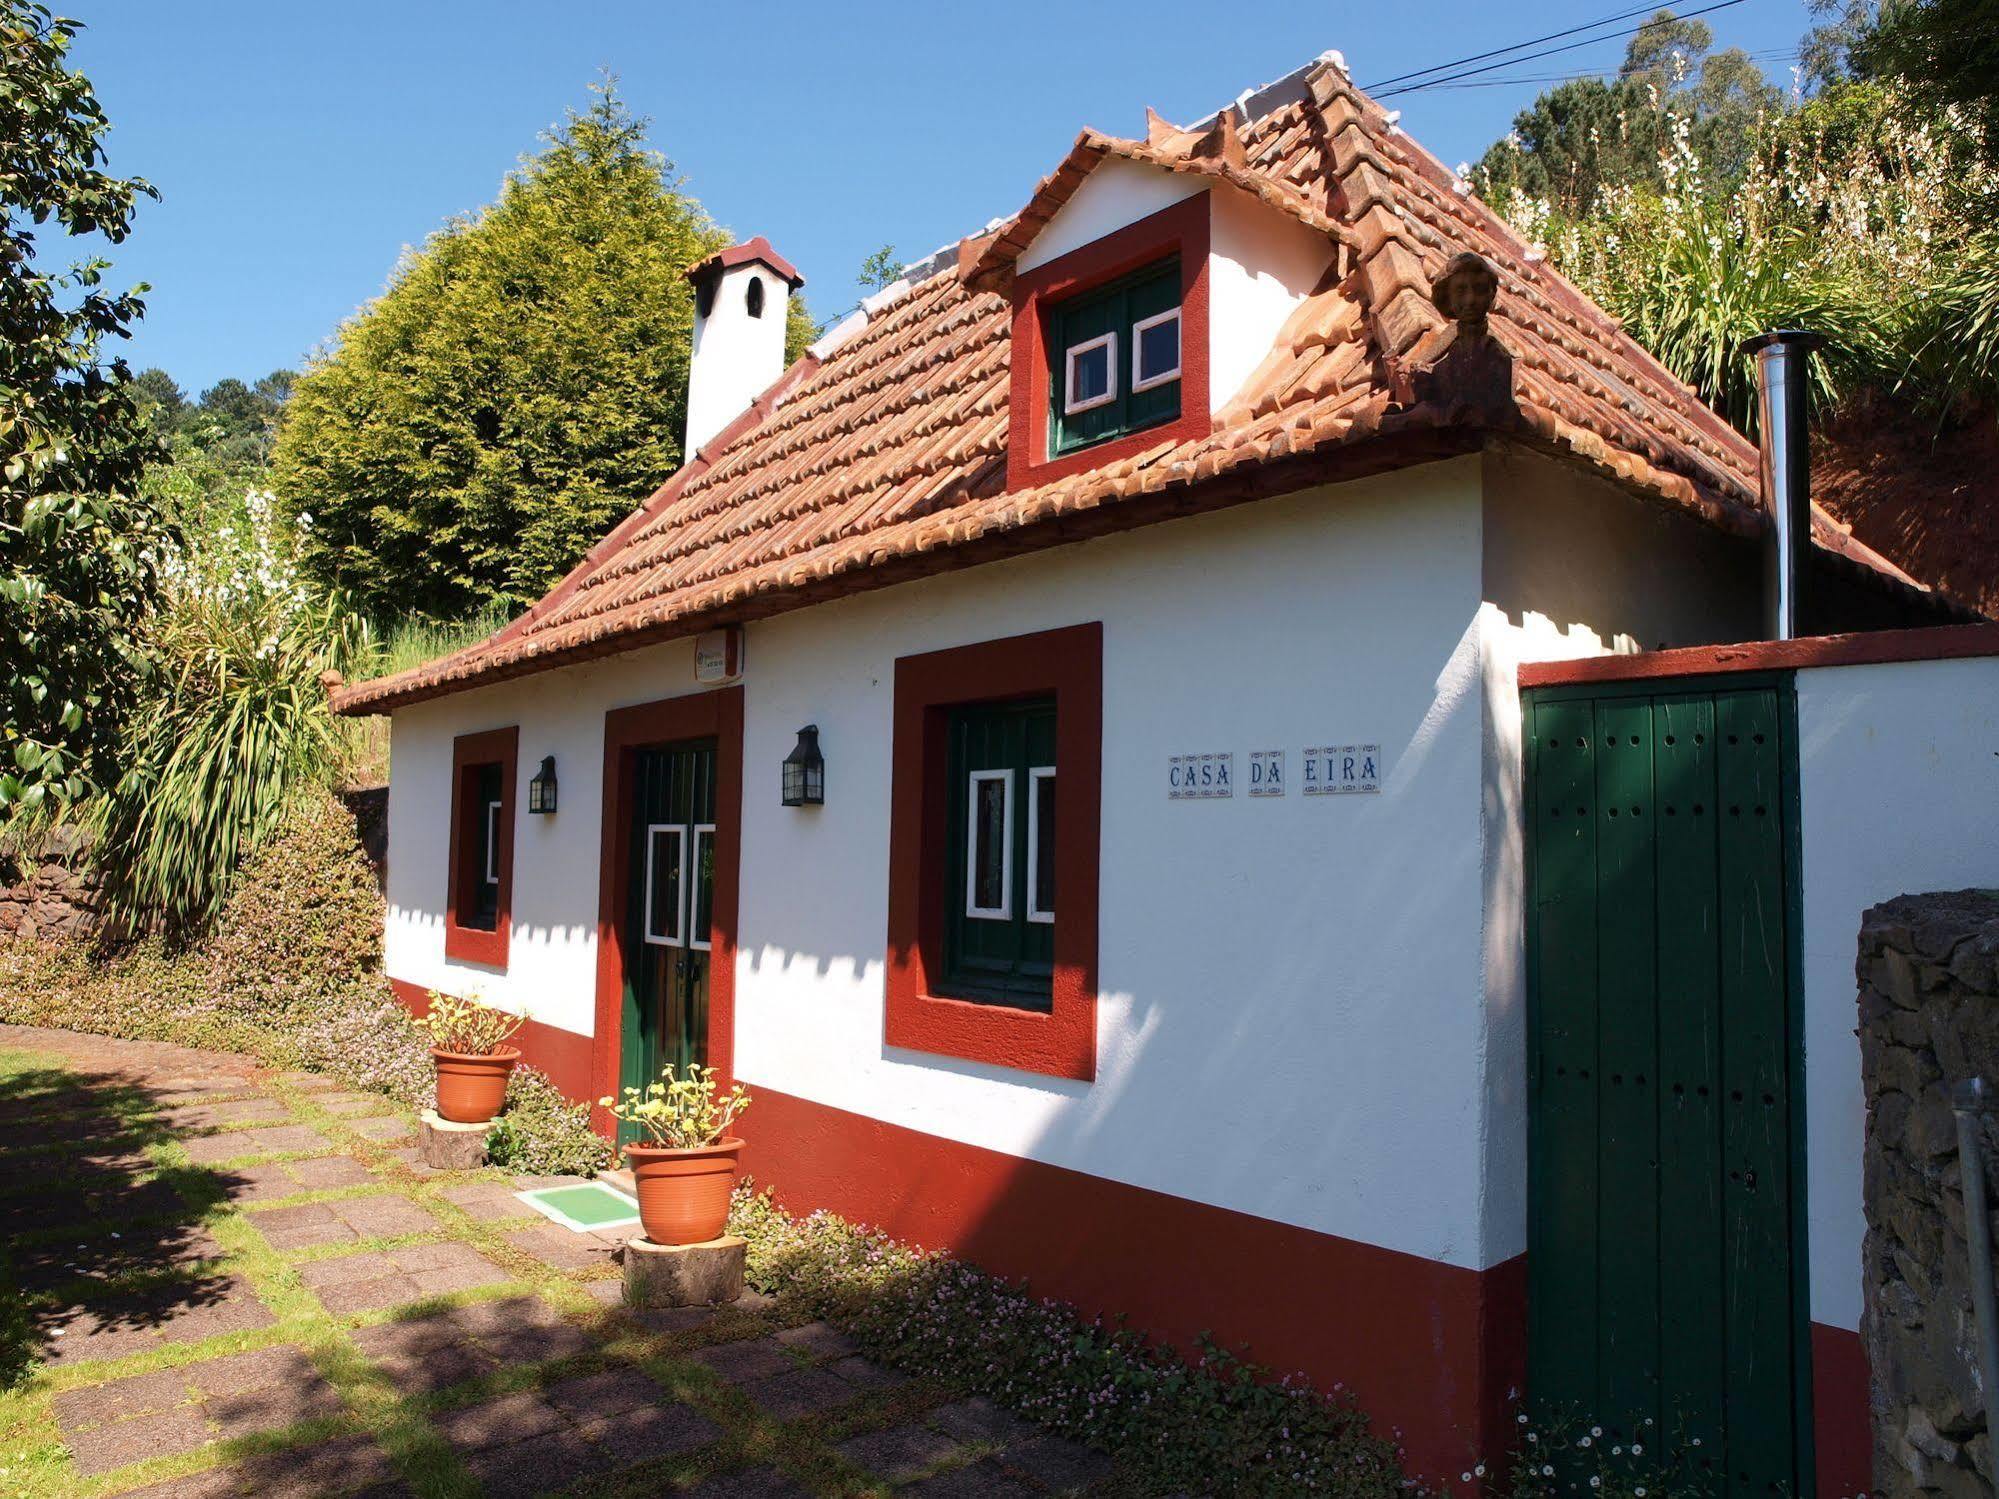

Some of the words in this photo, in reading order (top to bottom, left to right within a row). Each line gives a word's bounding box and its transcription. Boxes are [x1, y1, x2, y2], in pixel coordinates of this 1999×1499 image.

[1170, 764, 1228, 787] CASA
[1252, 761, 1281, 784] DA
[1305, 756, 1377, 780] EIRA
